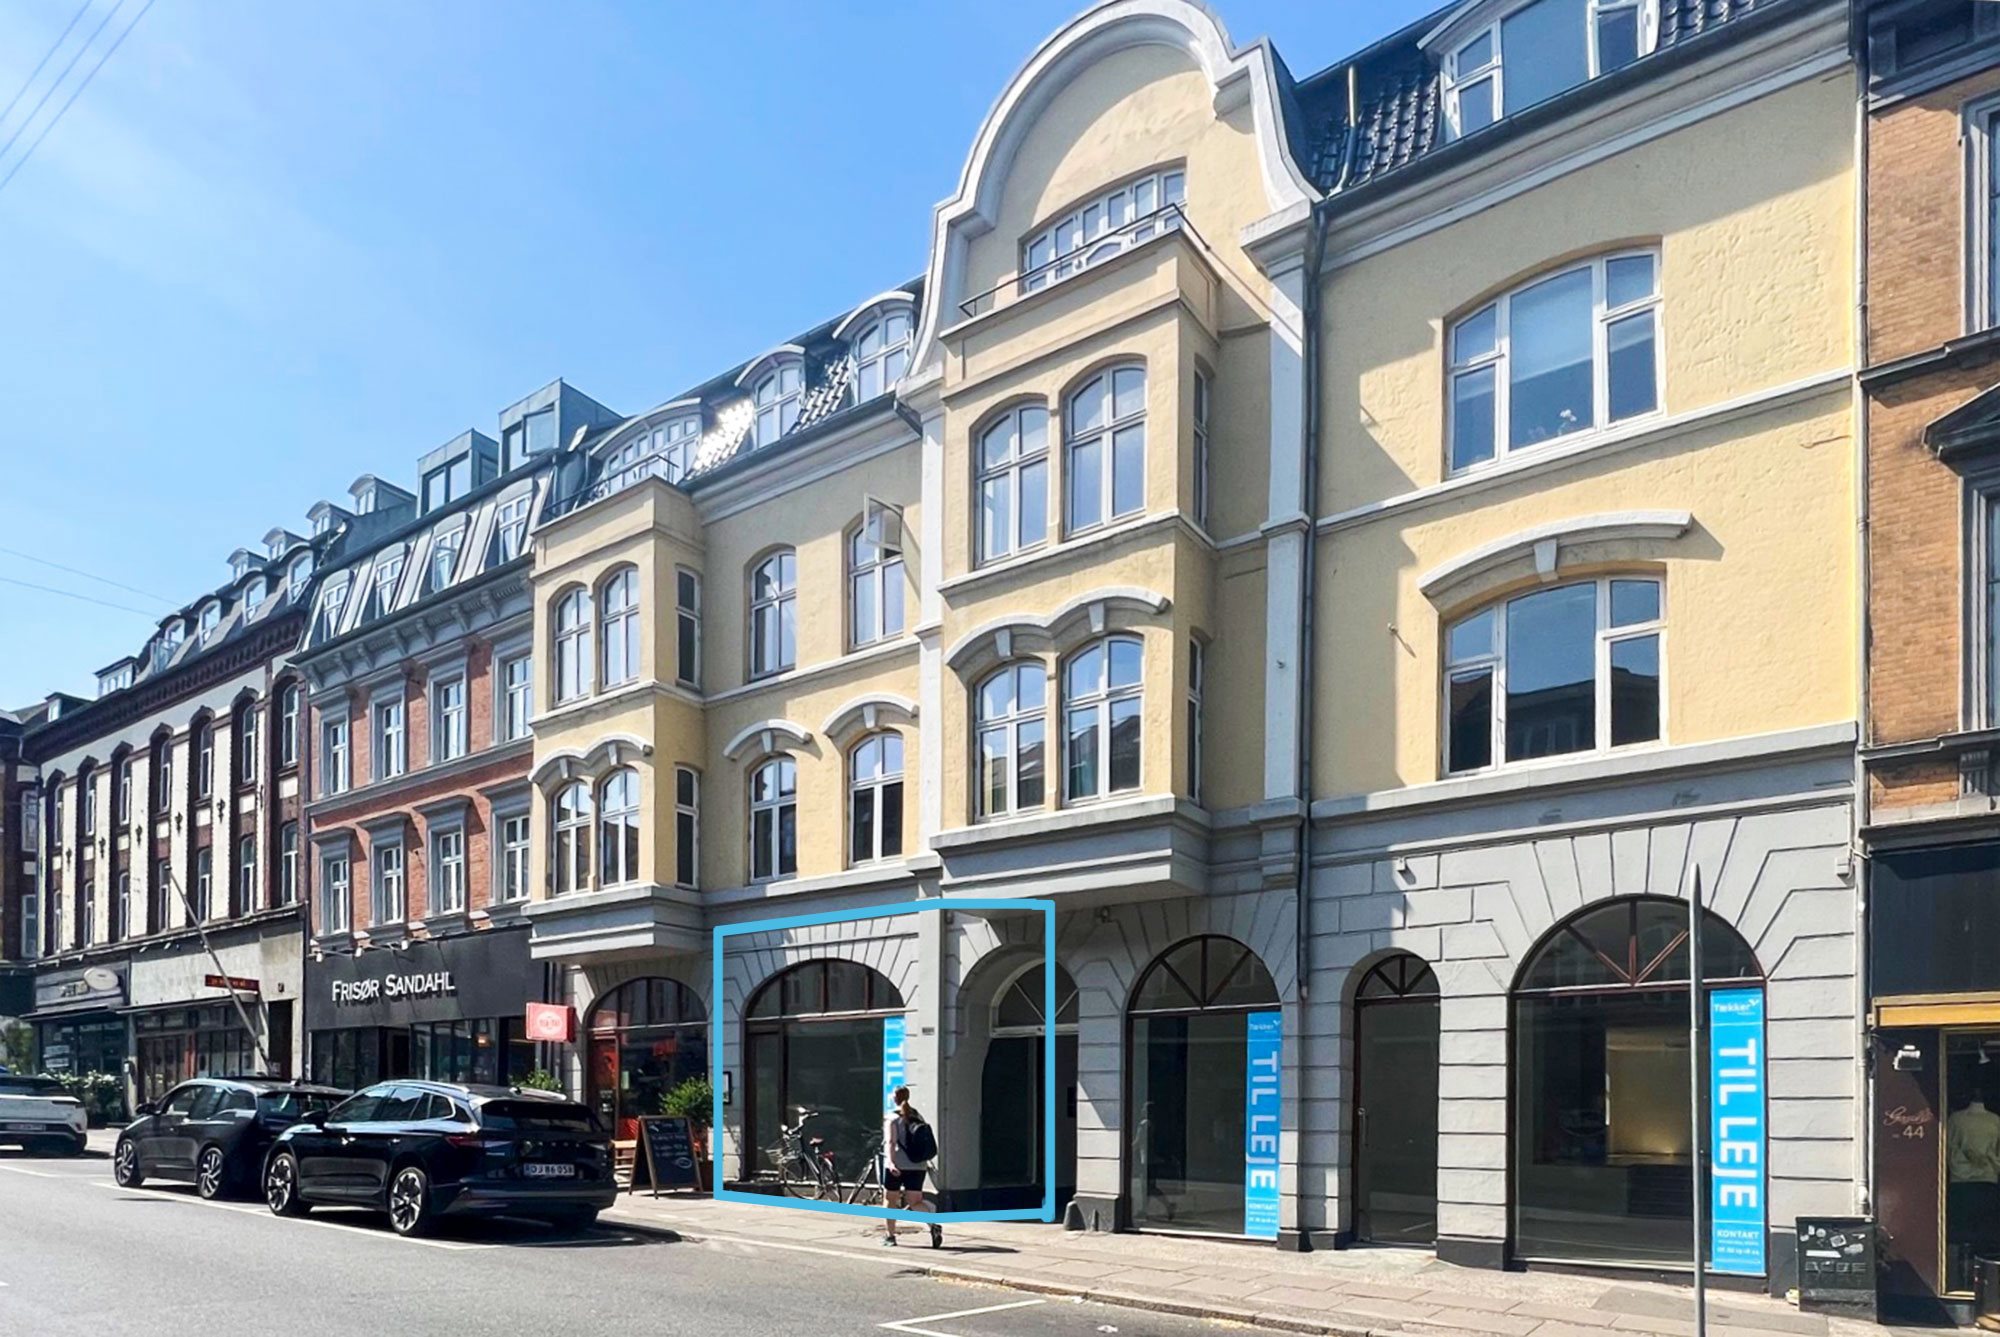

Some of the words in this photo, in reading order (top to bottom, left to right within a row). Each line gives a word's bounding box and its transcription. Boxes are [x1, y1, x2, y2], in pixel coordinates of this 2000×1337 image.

[332, 978, 379, 1001] FRISØR
[385, 971, 455, 996] SANDAHL
[1252, 1051, 1277, 1105] TIL
[1719, 1038, 1757, 1105] TIL
[1245, 1114, 1277, 1188] LEJE
[1903, 1125, 1924, 1139] 44
[1712, 1117, 1757, 1207] LEJE
[1717, 1229, 1760, 1239] KONTAKT
